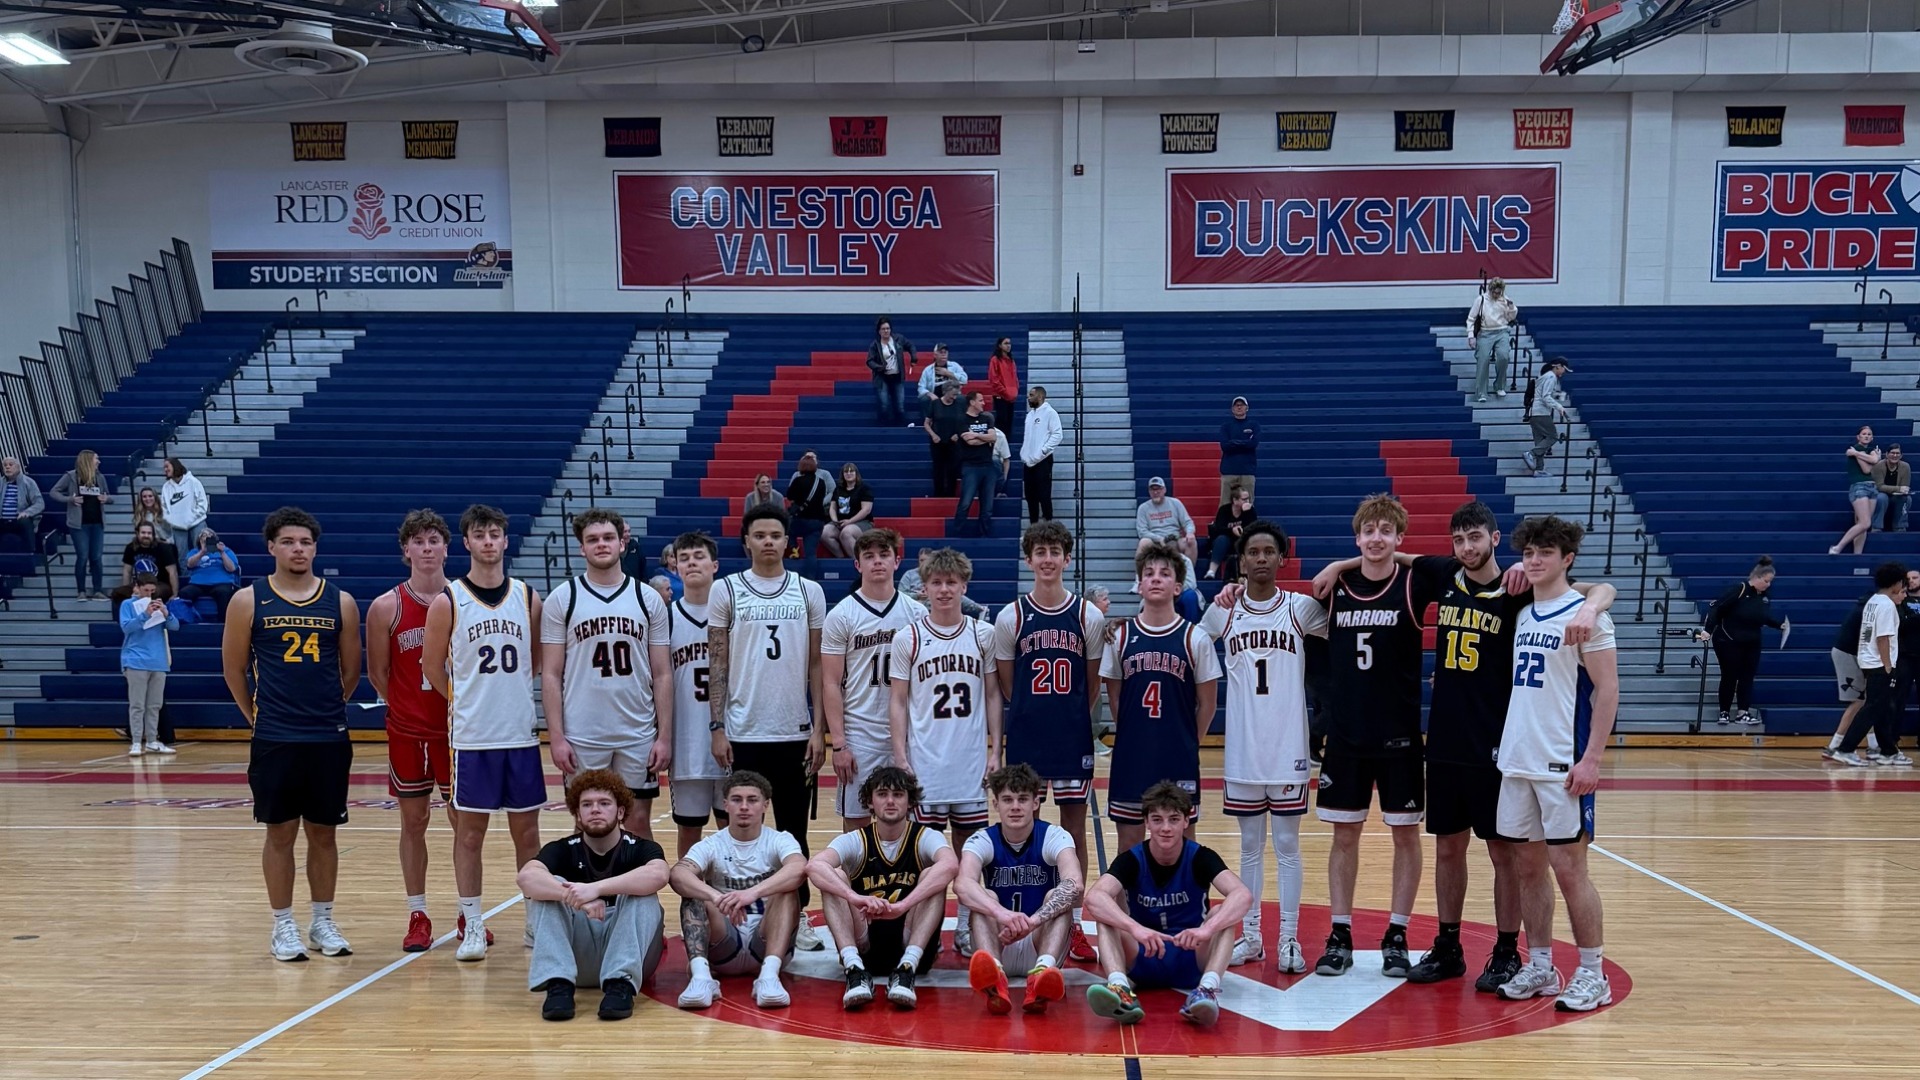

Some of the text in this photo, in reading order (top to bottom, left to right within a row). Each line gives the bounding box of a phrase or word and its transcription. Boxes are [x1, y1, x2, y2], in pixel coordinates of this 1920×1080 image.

[719, 119, 772, 136] LEBANON
[841, 119, 876, 136] J. P.
[945, 118, 998, 135] MANHEIM
[1163, 115, 1217, 132] MANHEIM
[1279, 114, 1333, 131] NORTHERN
[1405, 113, 1444, 129] PENN
[1516, 111, 1569, 129] PEQUEA
[1729, 118, 1781, 135] SOLANCO
[1850, 117, 1901, 134] WARWICK
[294, 124, 345, 140] LANCASTER
[405, 123, 456, 139] LANCASTER
[607, 129, 659, 145] LEBANON
[1400, 131, 1448, 148] MANOR
[1518, 129, 1568, 147] VALLEY
[407, 141, 456, 157] MENNONITE
[720, 137, 771, 154] CATHOLIC
[834, 138, 883, 155] McCASKEY
[946, 137, 998, 154] CENTRAL
[1164, 134, 1215, 151] TOWNSHIP
[1281, 132, 1330, 149] LEBANON
[296, 142, 344, 158] CATHOLIC
[281, 181, 348, 190] LANCASTER
[1725, 171, 1900, 216] BUCK
[275, 194, 486, 223] RED ROSE
[670, 186, 942, 229] CONESTOGA
[400, 228, 482, 238] CREDIT UNION
[1194, 194, 1531, 257] BUCKSKINS
[715, 233, 899, 275] VALLEY
[1722, 227, 1918, 271] PRIDE
[250, 265, 437, 283] STUDENT SECTION
[454, 270, 513, 281] Buckskins
[265, 616, 333, 628] RAIDERS
[737, 605, 802, 621] WARRIORS
[1336, 610, 1400, 627] WARRIORS
[1438, 605, 1502, 634] SOLANCO
[468, 619, 523, 643] EPHRATA
[574, 616, 644, 642] HEMPFIELD
[282, 631, 320, 662] 24
[765, 625, 781, 660] 3
[1020, 629, 1083, 657] OCTORARA
[1229, 630, 1297, 656] OCTORARA
[1515, 632, 1561, 650] COCALICO
[478, 644, 518, 674] 20
[592, 640, 633, 677] 40
[1356, 632, 1373, 670] 5
[1444, 630, 1480, 671] 15
[918, 653, 980, 682] OCTORARA
[1123, 651, 1187, 681] OCTORARA
[1513, 651, 1545, 688] 22
[1031, 658, 1072, 694] 20
[1254, 658, 1269, 695] 1
[933, 682, 972, 719] 23
[1142, 681, 1162, 718] 4
[989, 864, 1048, 888] PIONEERS
[1012, 892, 1022, 913] 1
[1137, 890, 1189, 908] COCALICO
[1160, 912, 1168, 930] 1
